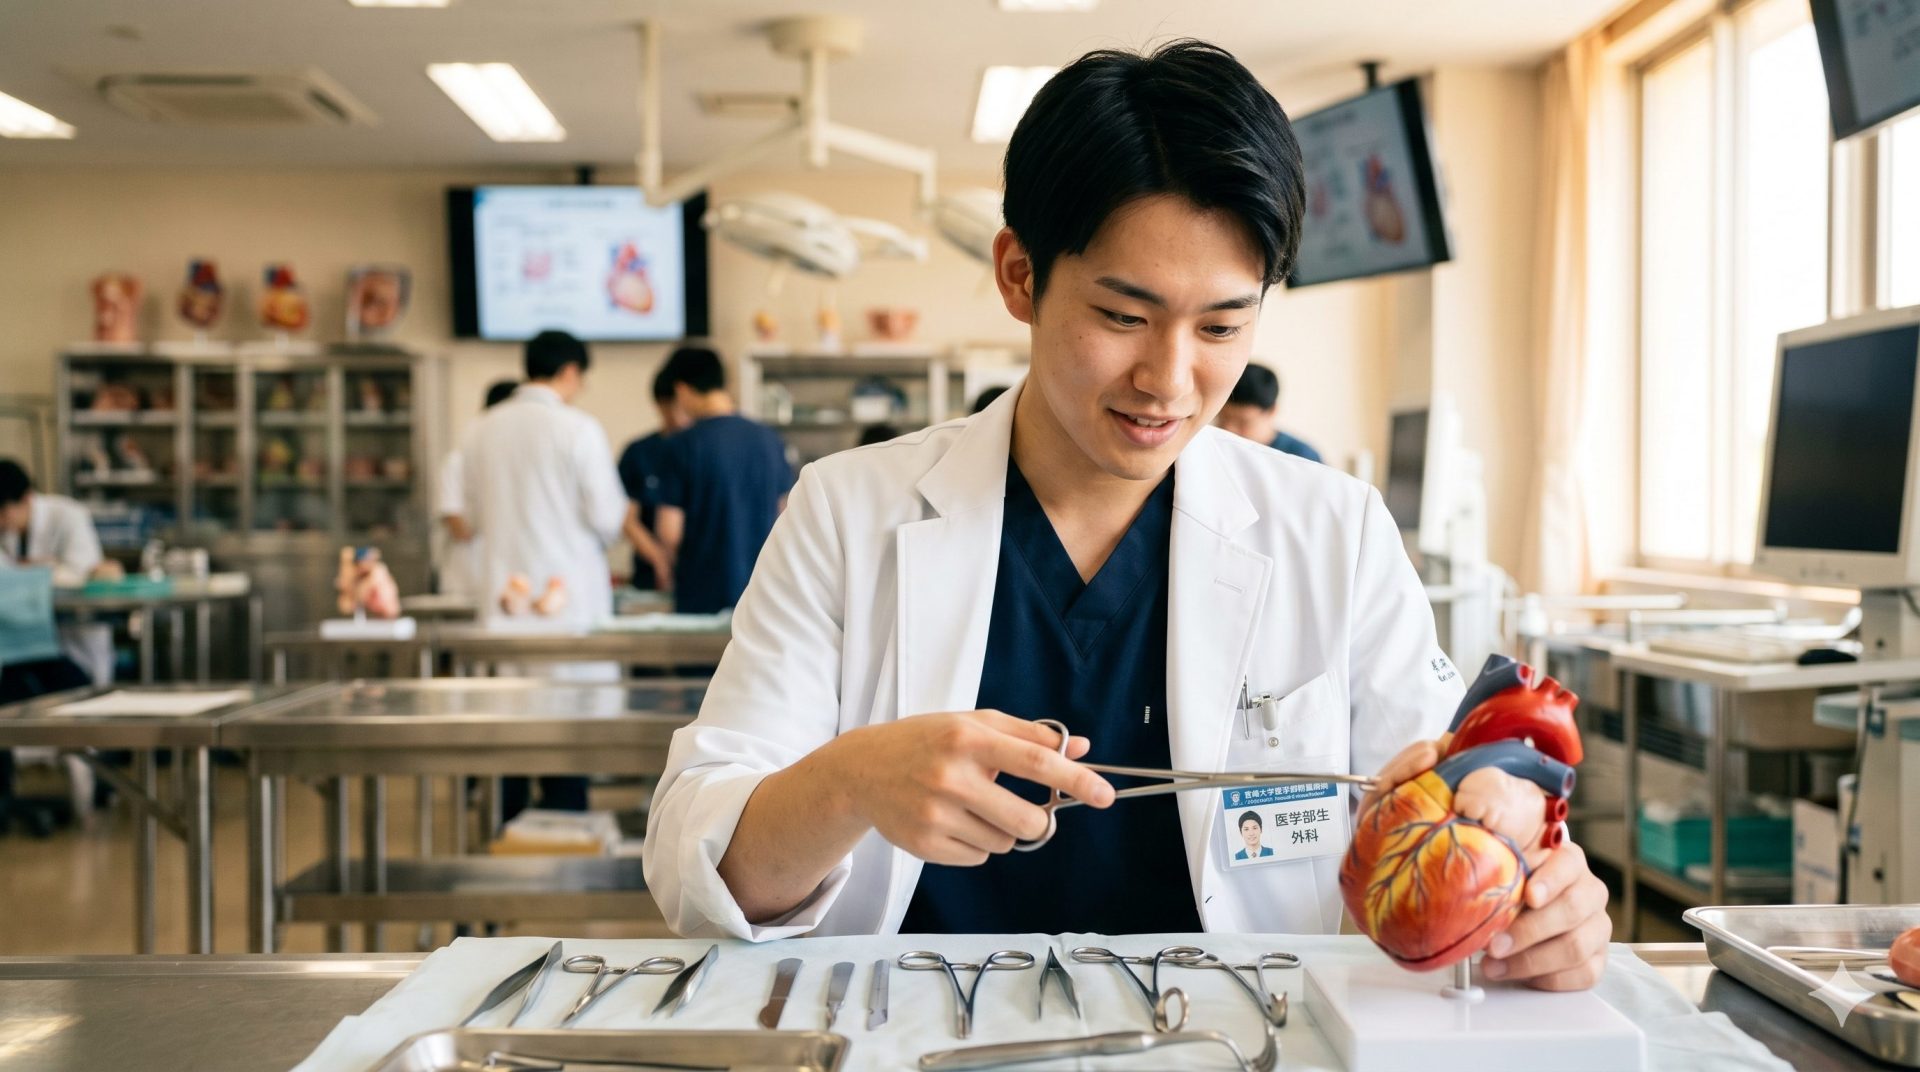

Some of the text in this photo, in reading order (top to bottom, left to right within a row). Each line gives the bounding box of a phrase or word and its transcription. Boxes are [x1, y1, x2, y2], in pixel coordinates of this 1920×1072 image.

[1275, 808, 1331, 827] 医学部生
[1291, 828, 1319, 845] 外科
